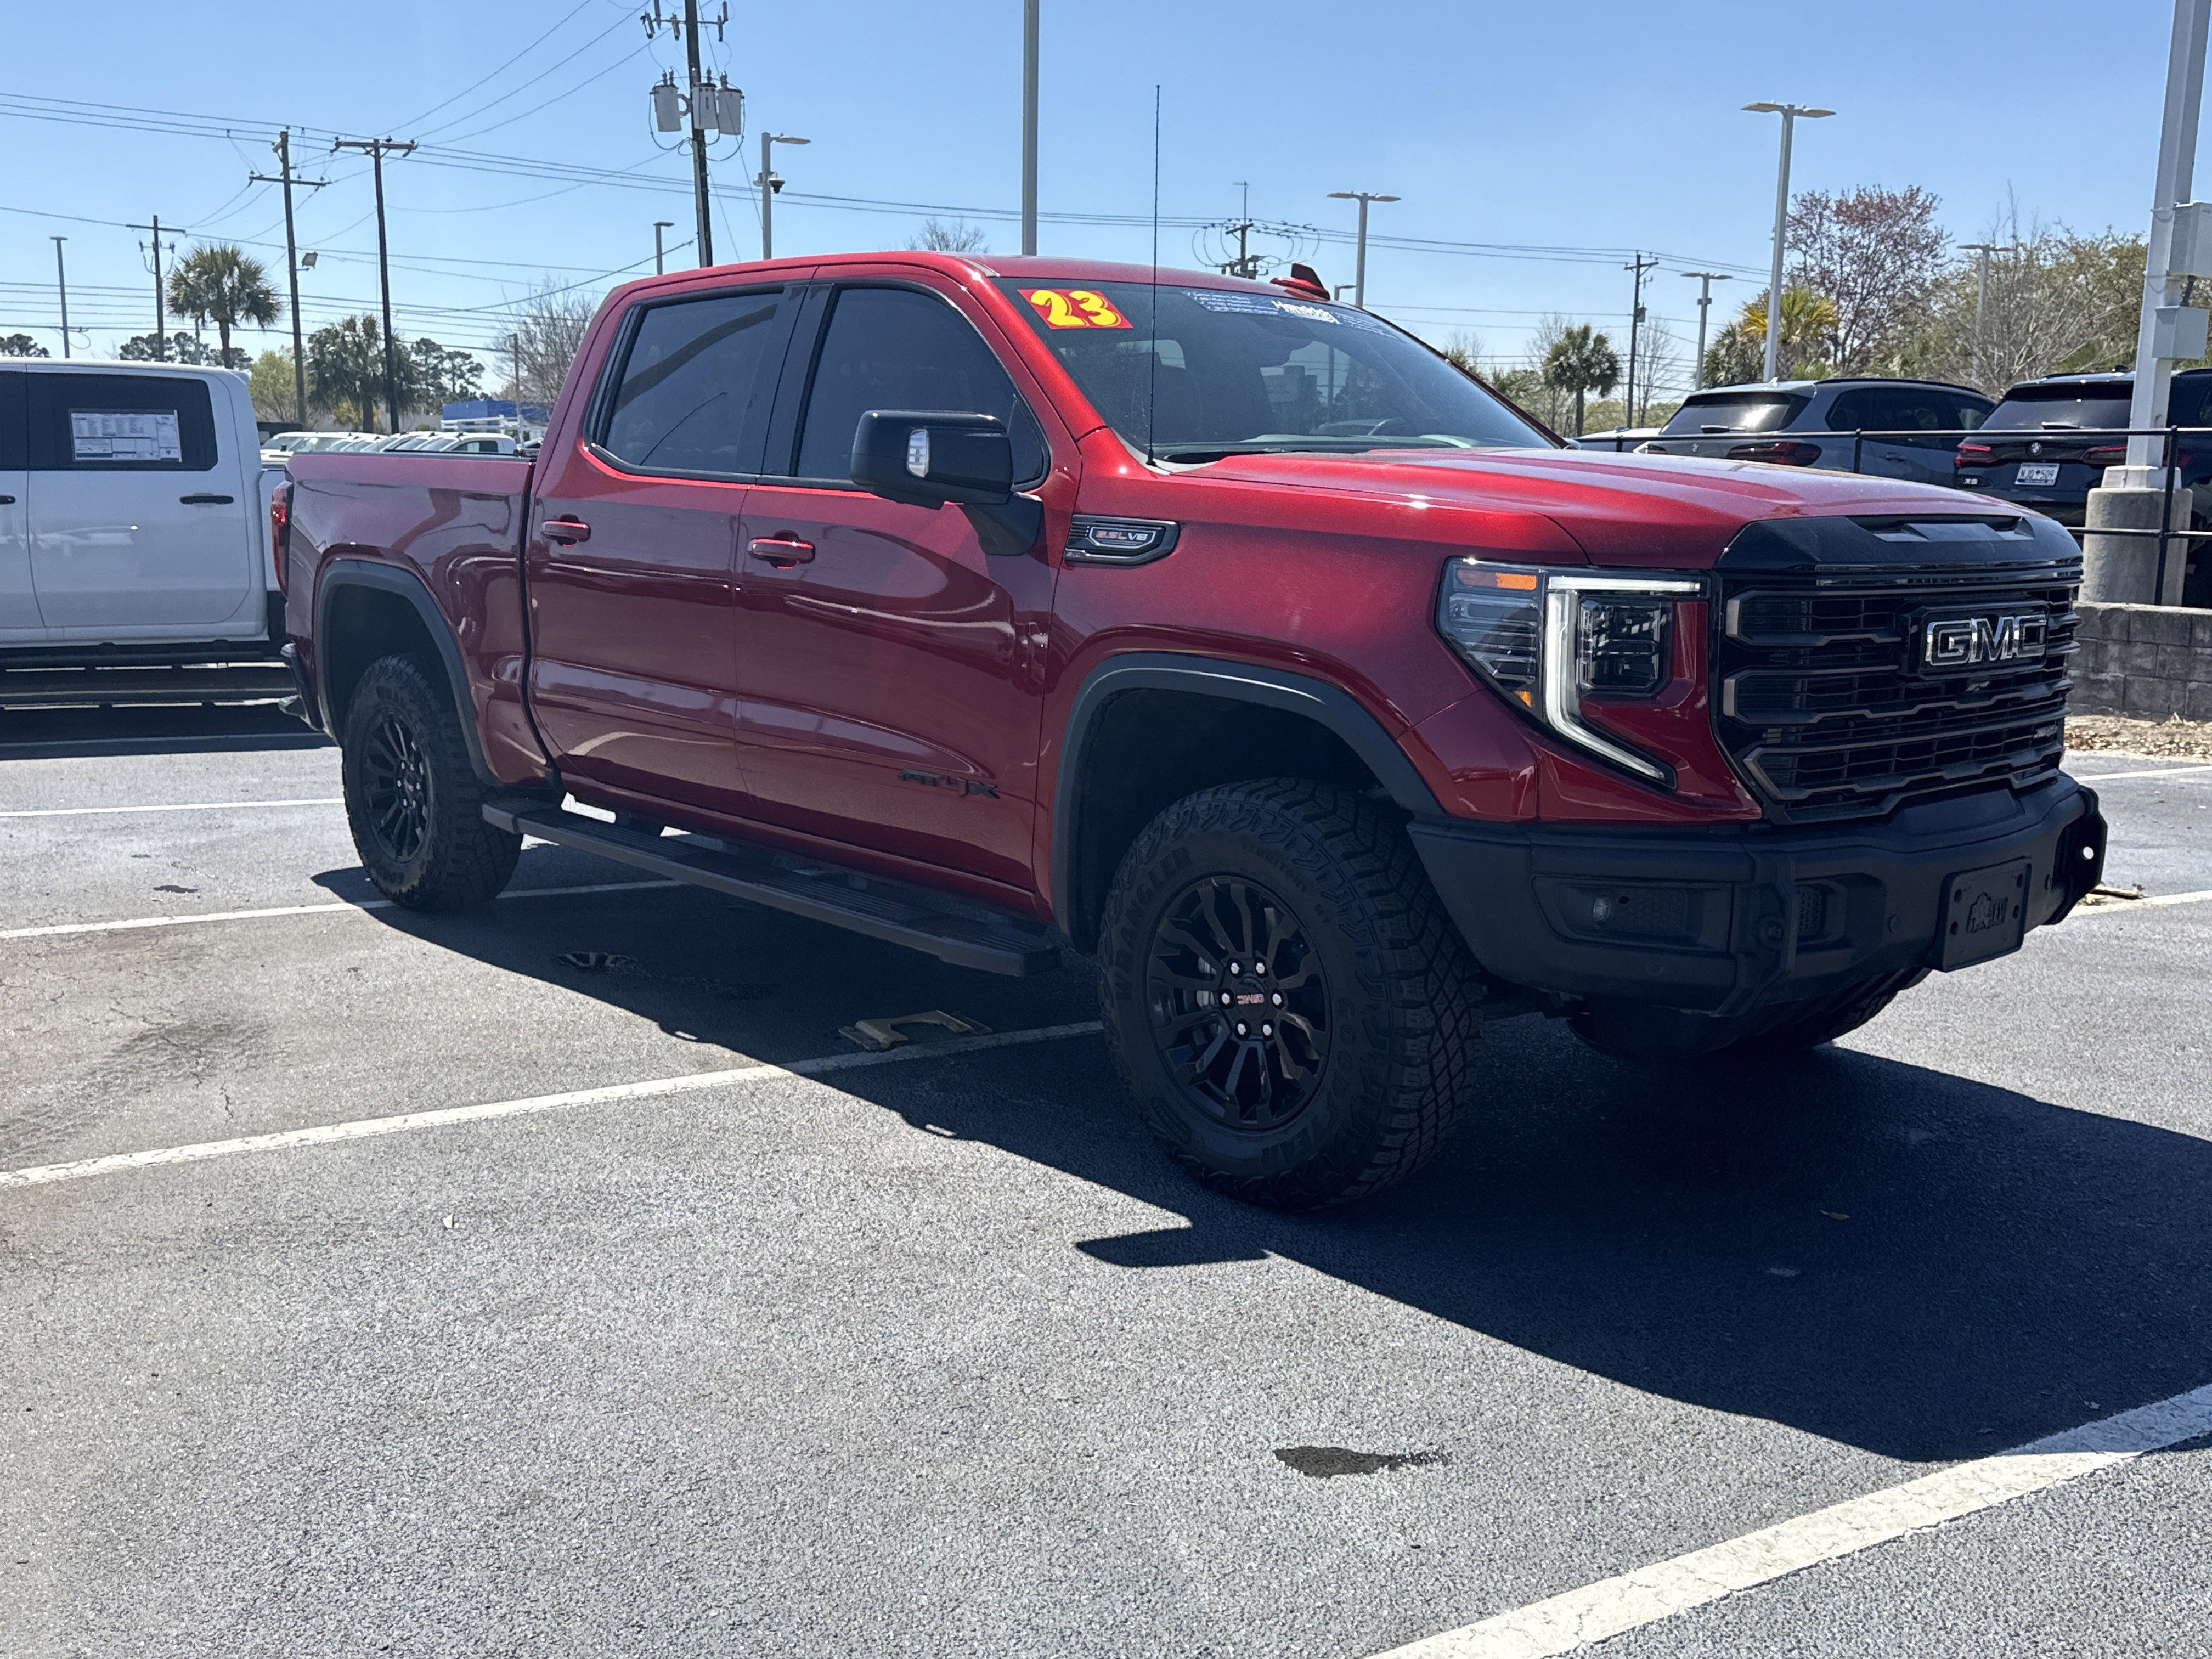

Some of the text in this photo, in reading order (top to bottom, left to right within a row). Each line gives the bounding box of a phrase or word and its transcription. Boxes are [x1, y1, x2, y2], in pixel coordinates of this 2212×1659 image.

[1030, 289, 1121, 327] 23
[1925, 614, 2047, 666] GMC
[1115, 845, 1193, 1001] WRANGLER
